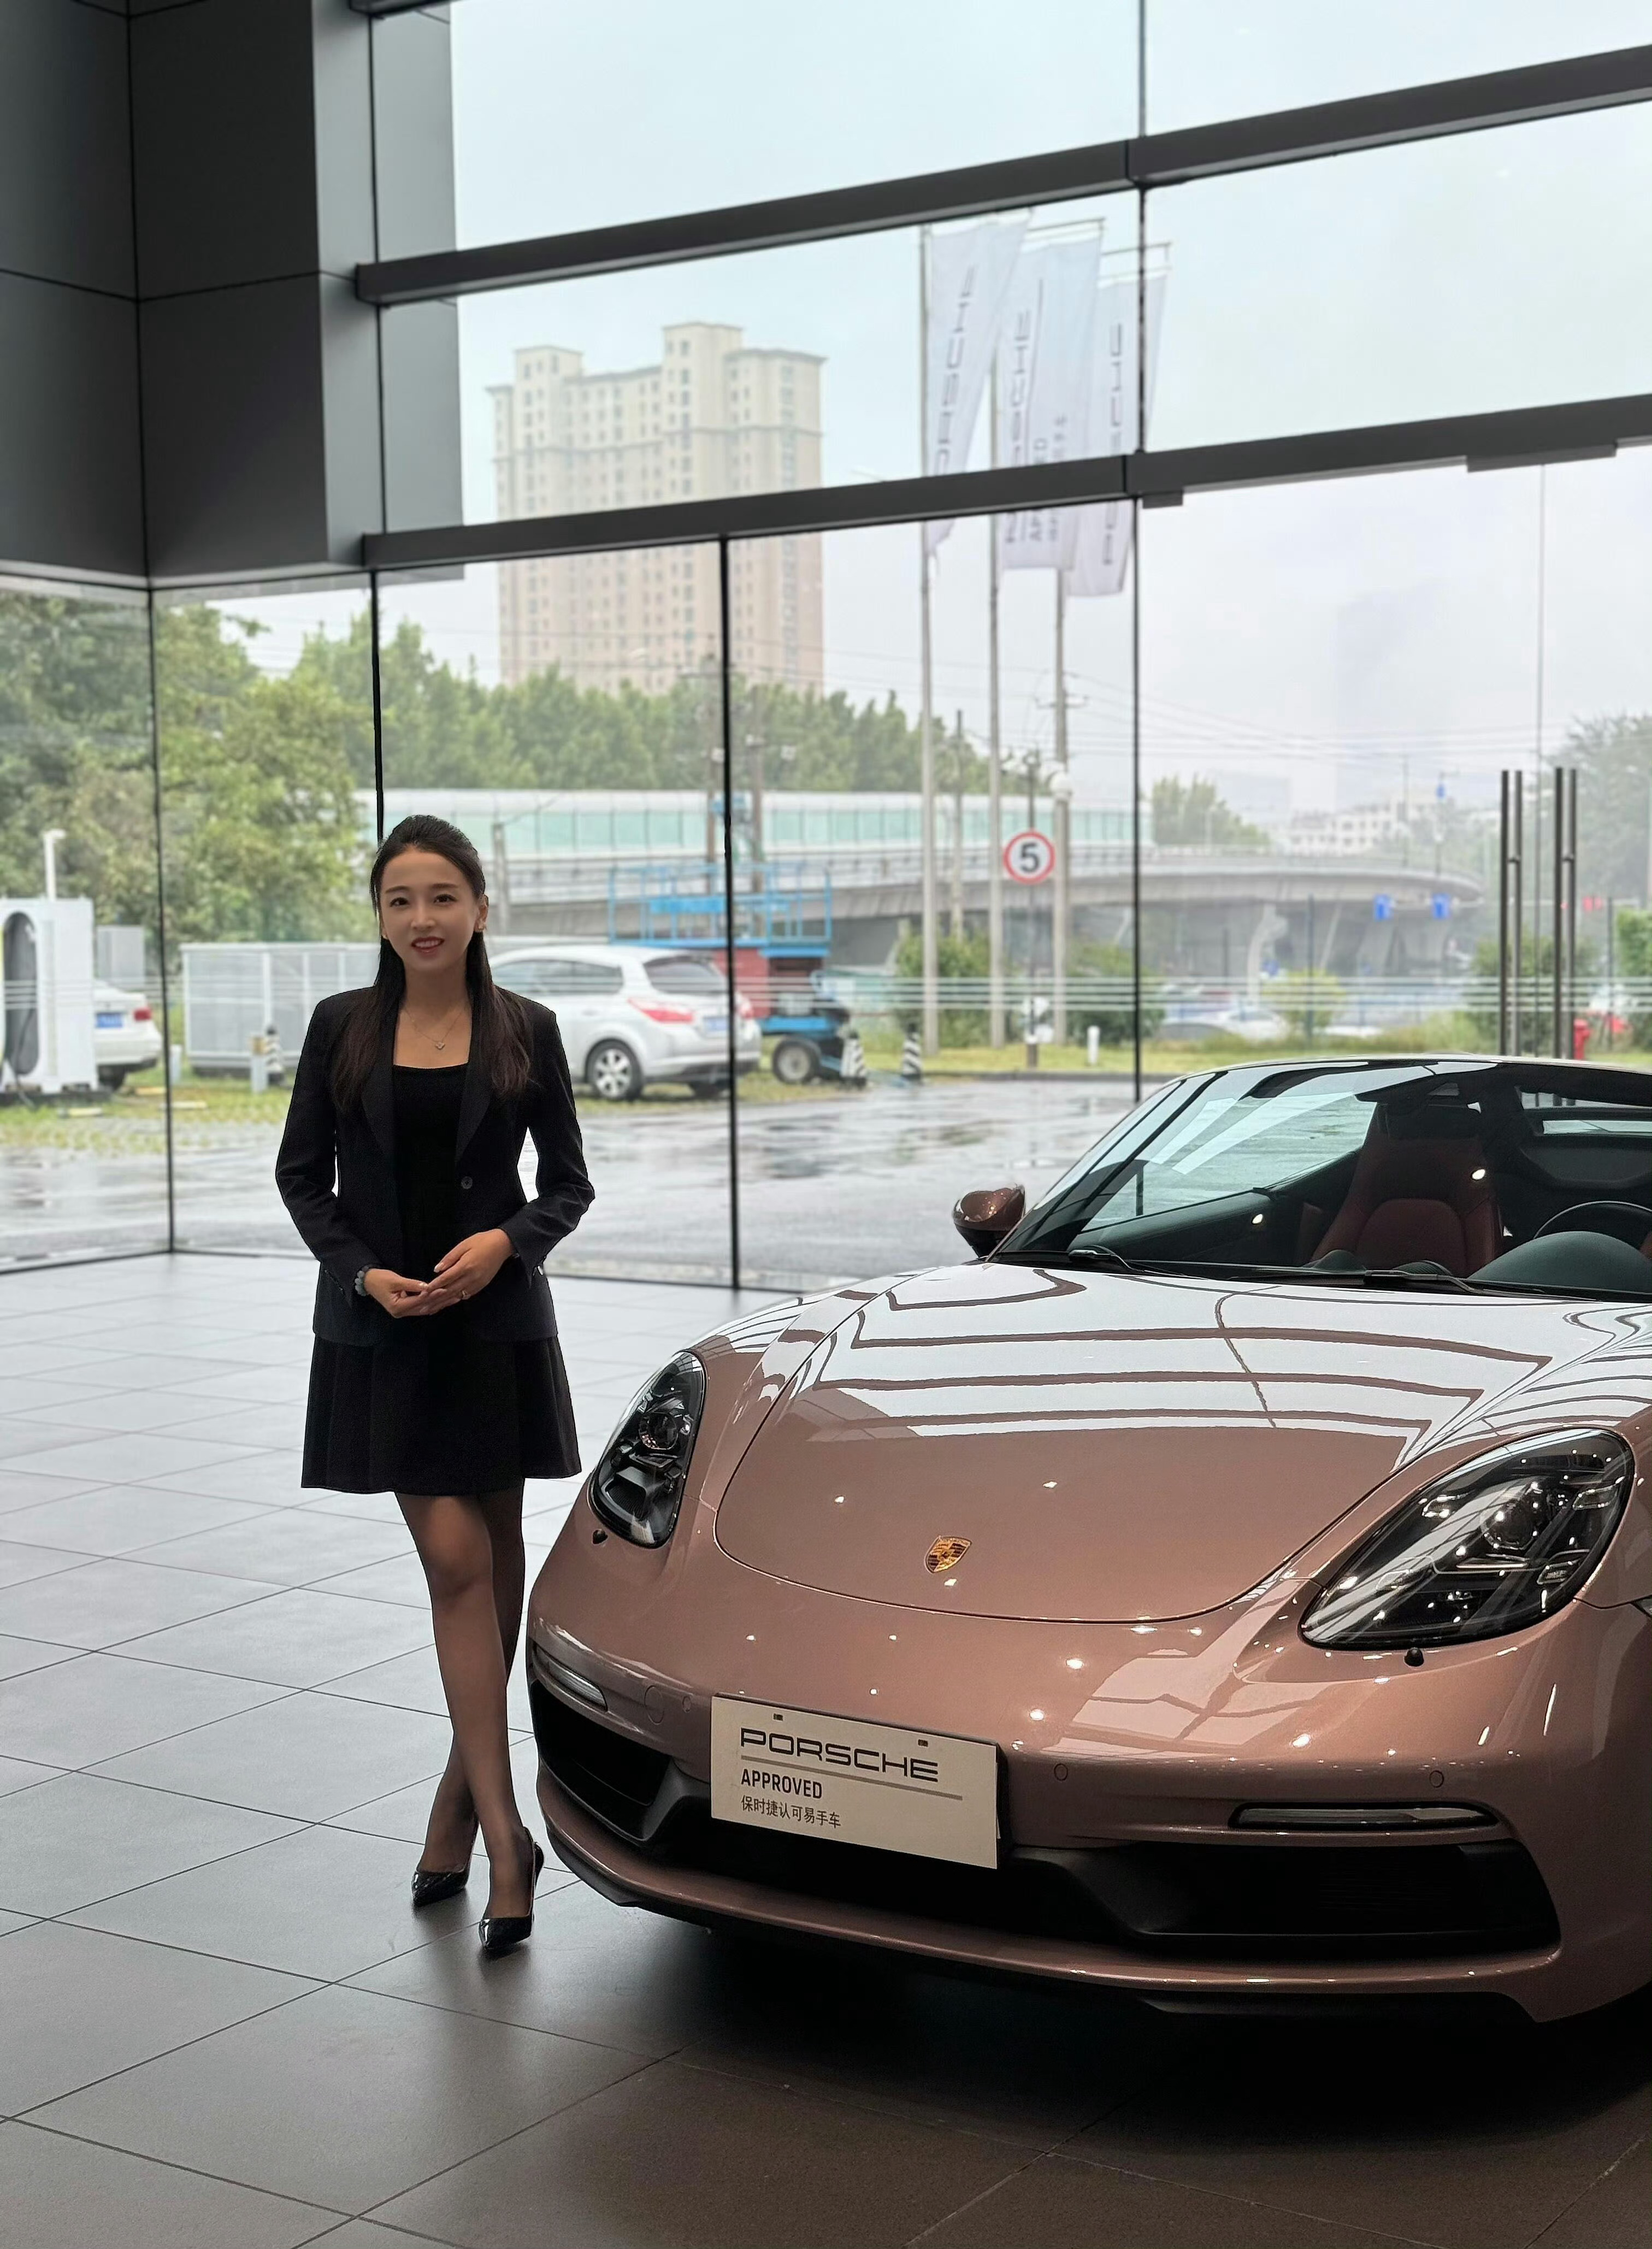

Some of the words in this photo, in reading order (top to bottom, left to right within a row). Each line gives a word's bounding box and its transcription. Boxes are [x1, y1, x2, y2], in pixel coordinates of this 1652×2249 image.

[1020, 842, 1040, 873] 5
[741, 1727, 939, 1782] PORSCHE
[741, 1768, 822, 1799] APPROVED
[741, 1795, 841, 1829] 保时捷认可易手车
